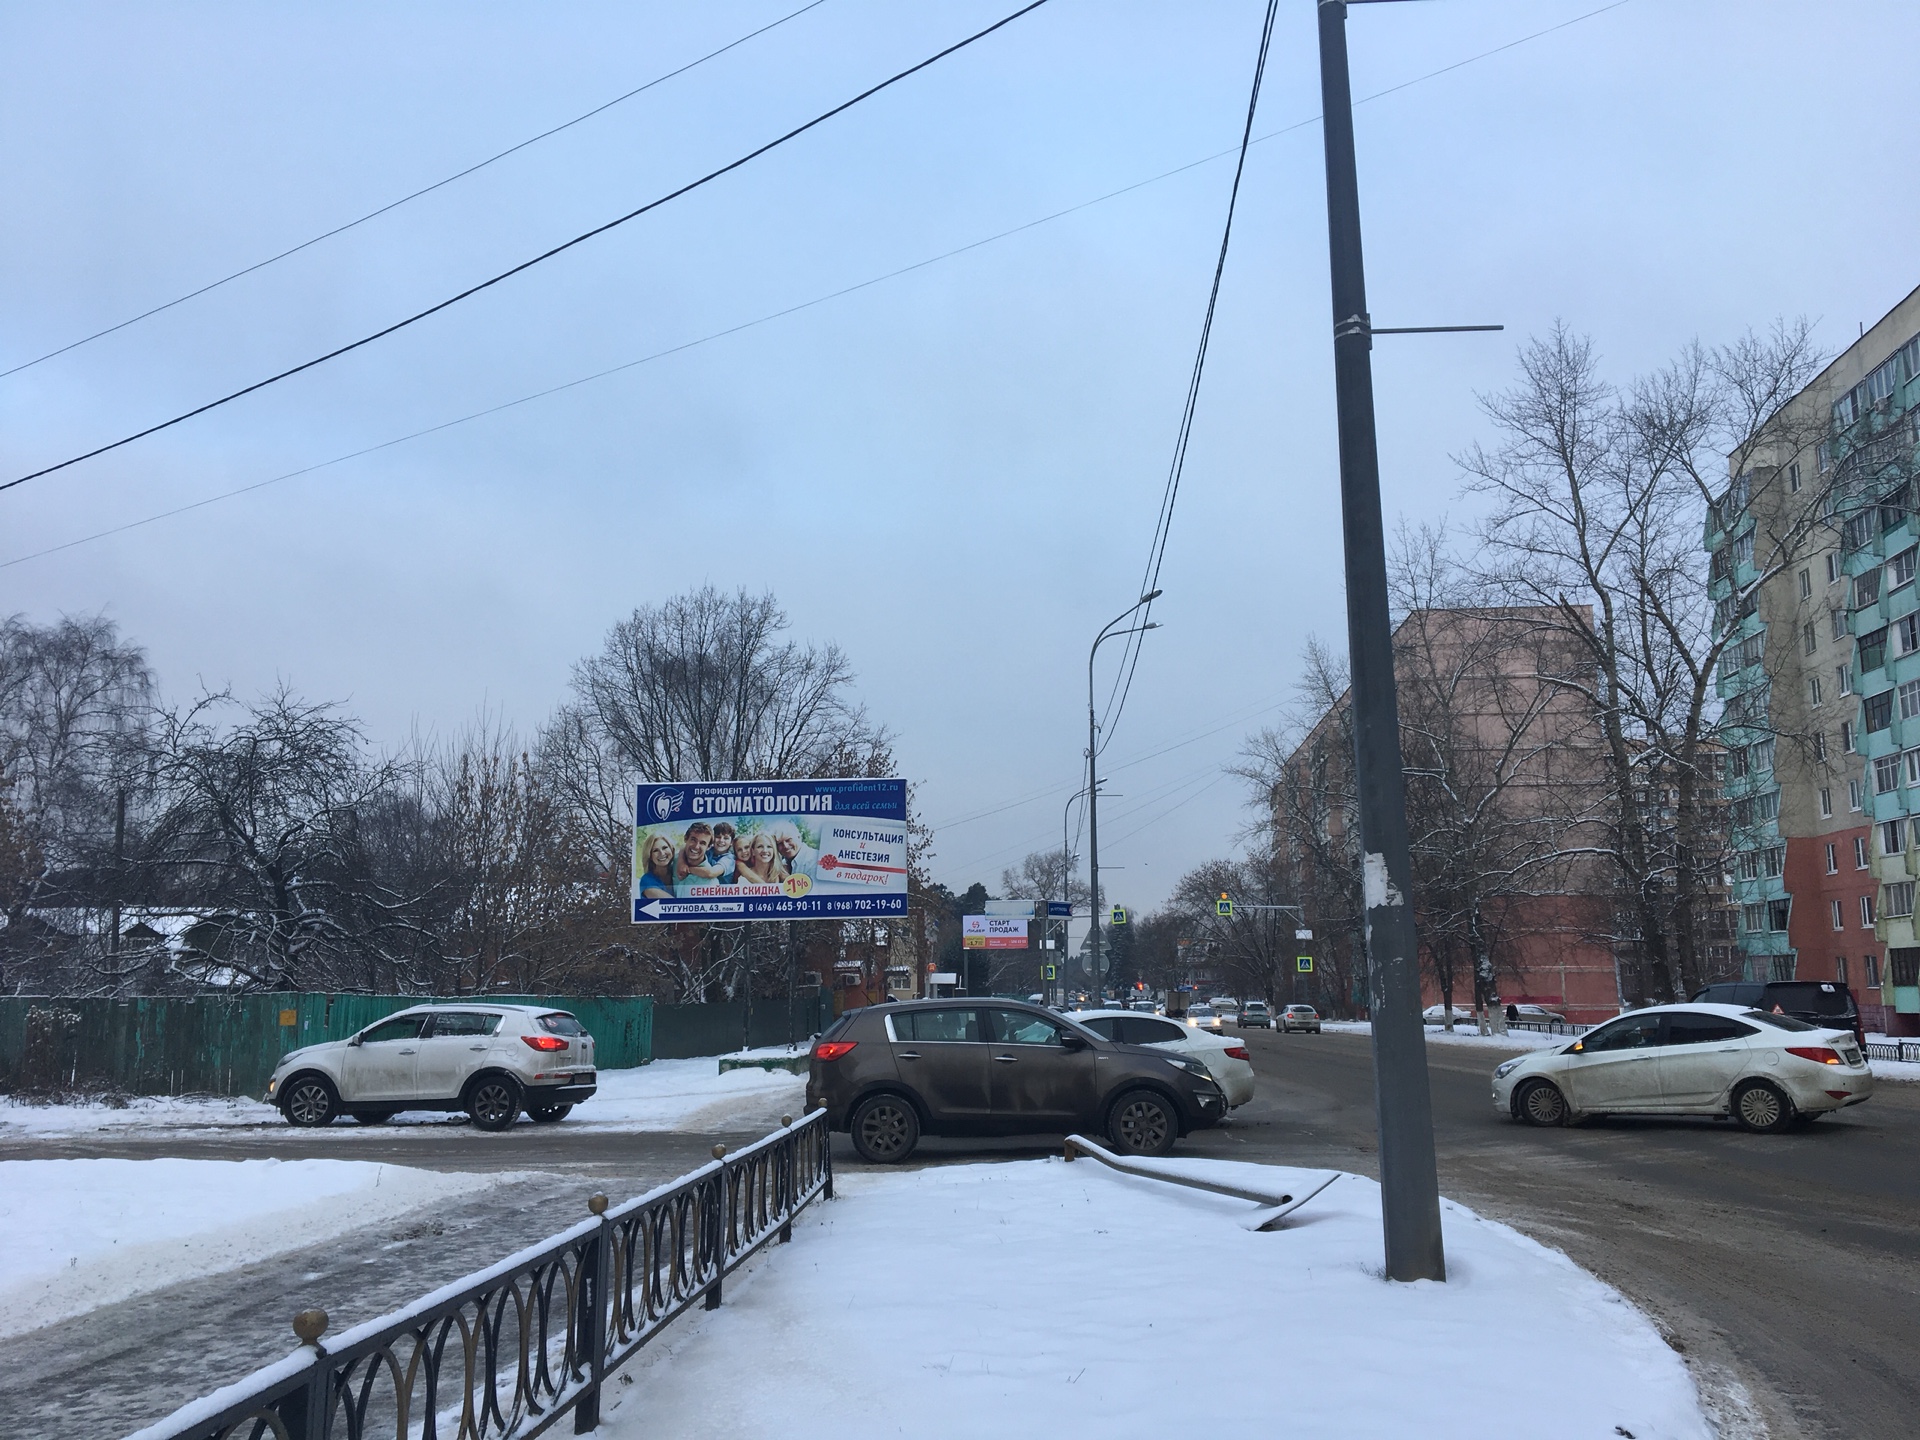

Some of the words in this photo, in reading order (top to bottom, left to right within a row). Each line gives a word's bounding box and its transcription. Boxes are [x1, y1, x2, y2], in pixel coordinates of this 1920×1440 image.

[694, 787, 743, 796] ПРОФИДЕНТ
[747, 786, 773, 795] ГРУПП
[815, 783, 898, 793] www.profident12.ru
[692, 794, 832, 814] СТОМАТОЛОГИЯ
[834, 801, 850, 810] для
[852, 800, 870, 810] всей
[833, 828, 904, 844] КОНСУЛЬТАЦИЯ
[838, 849, 890, 863] АНЕСТЕЗИЯ
[844, 870, 889, 885] подарок!
[690, 885, 740, 896] СЕМЕЙНАЯ
[742, 886, 780, 897] СКИДКА
[786, 877, 809, 893] -7%
[661, 904, 708, 913] ЧУГУНОВА,
[748, 903, 754, 912] 8
[755, 902, 774, 912] (496)
[776, 901, 821, 911] 465-90-11
[827, 902, 832, 910] 8
[833, 901, 853, 911] (968)
[854, 899, 902, 910] 702-19-60
[989, 926, 1020, 934] ПРОДАЖ
